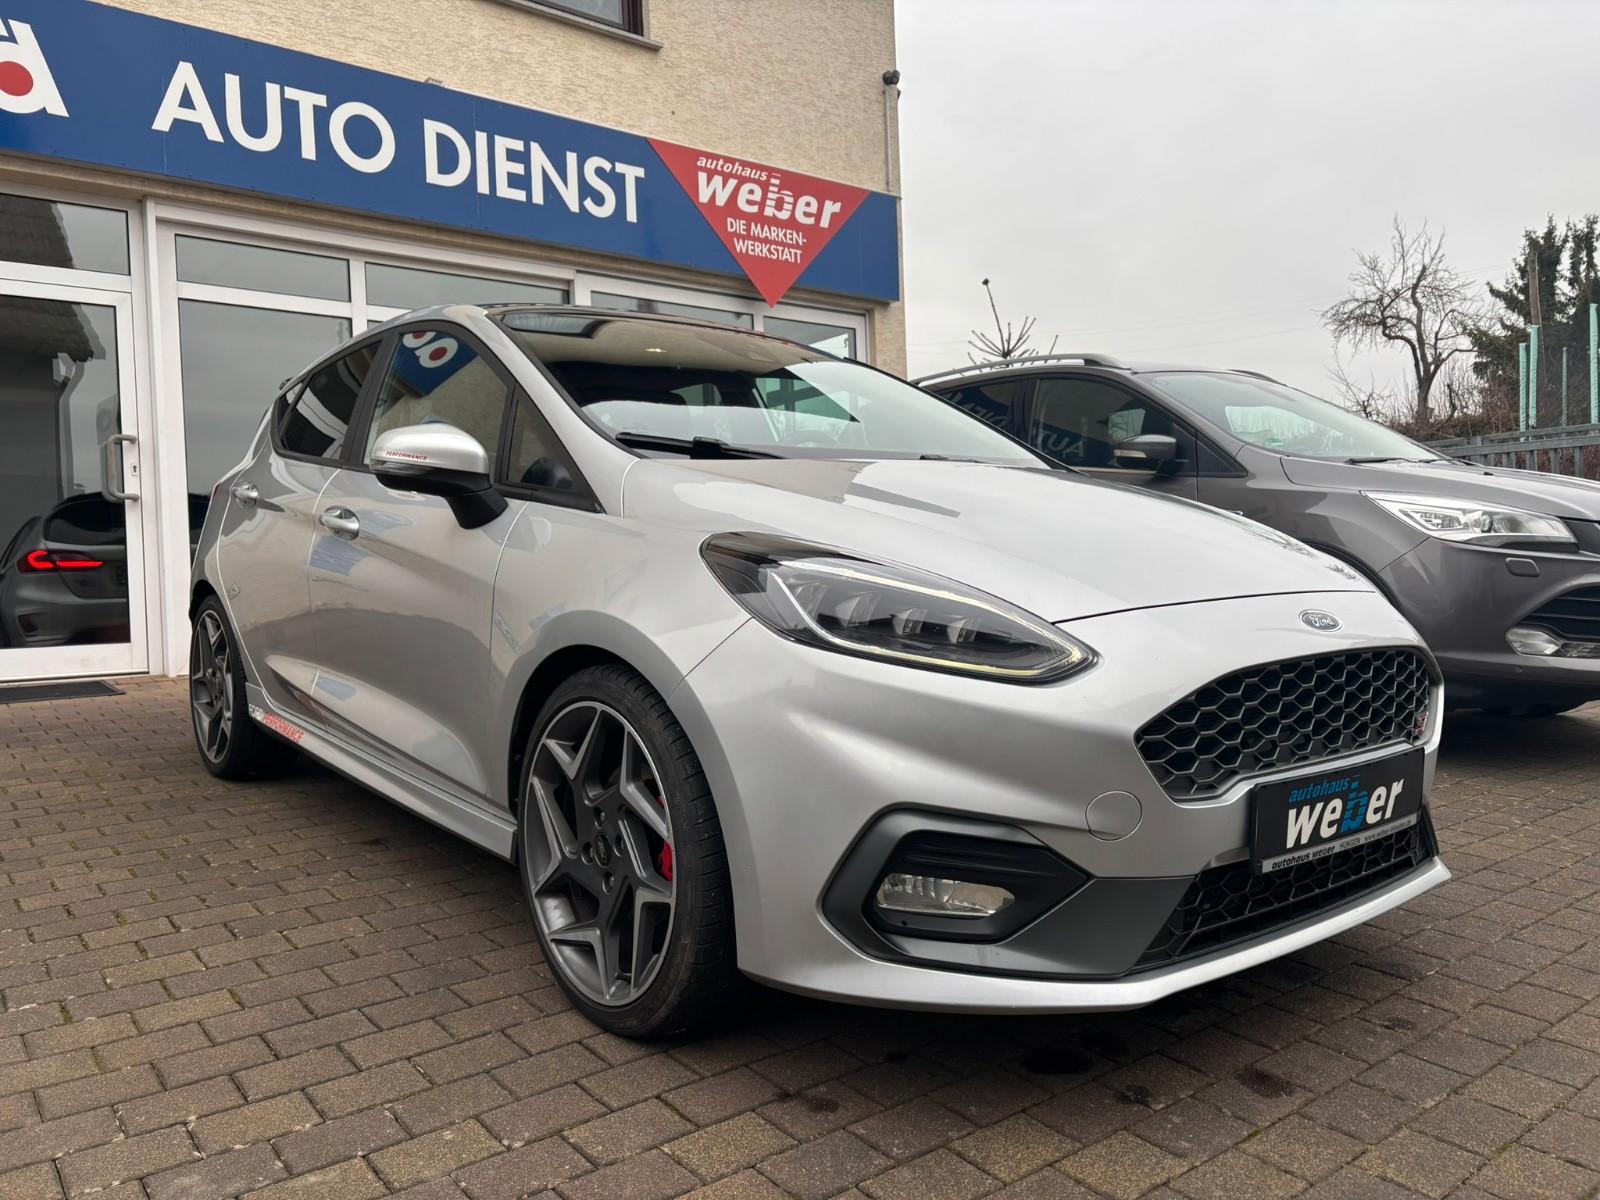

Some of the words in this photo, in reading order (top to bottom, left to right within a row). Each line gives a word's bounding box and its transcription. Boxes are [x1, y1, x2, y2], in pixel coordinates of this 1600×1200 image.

[151, 61, 396, 174] AUTO
[423, 118, 645, 224] DIENST
[697, 156, 768, 181] autohaus
[697, 172, 842, 229] weber
[726, 217, 747, 235] DIE
[750, 223, 807, 246] MARKEN-
[733, 237, 802, 264] WERKSTATT
[386, 450, 428, 461] PERFORMANCE
[1289, 777, 1350, 803] autohaus
[1286, 776, 1405, 849] weber
[1272, 853, 1310, 869] autohaus
